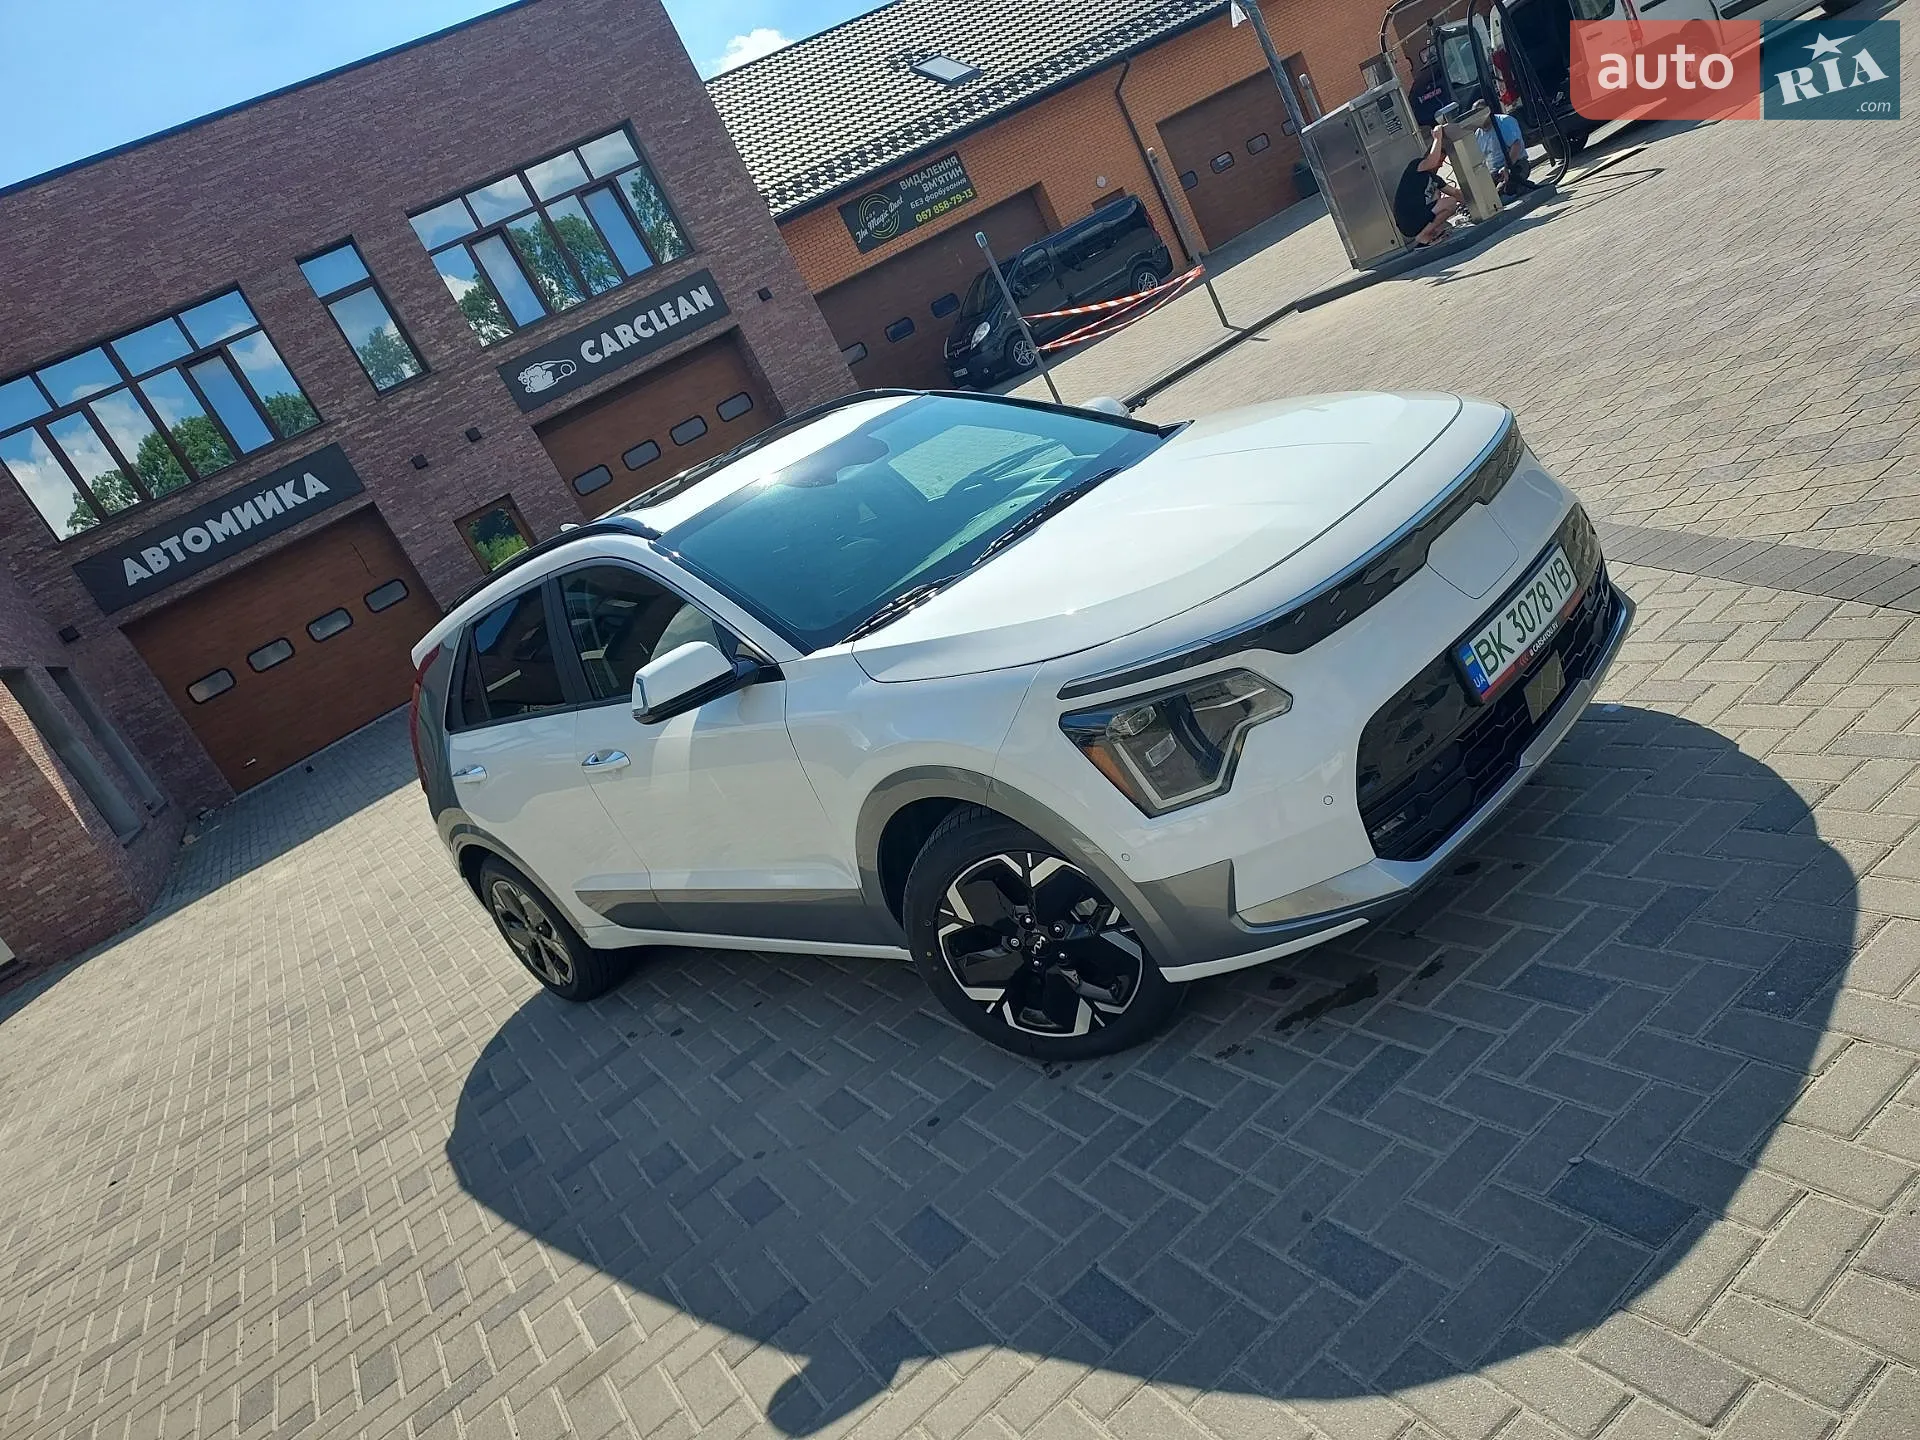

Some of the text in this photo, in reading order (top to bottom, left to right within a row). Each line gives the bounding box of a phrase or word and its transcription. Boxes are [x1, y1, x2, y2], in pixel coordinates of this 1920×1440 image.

[899, 155, 959, 191] ВИДАЛЕННЯ
[922, 166, 964, 193] ВМ'ЯТИН
[855, 227, 869, 244] The
[867, 209, 889, 231] Magic
[889, 195, 904, 213] Dent
[910, 197, 925, 209] БЕЗ
[915, 208, 933, 223] 067
[933, 188, 974, 215] 858-79-13
[580, 285, 715, 364] CARCLEAN
[122, 472, 331, 586] АВТОМИЙКА
[1474, 557, 1572, 677] BK 3078 YB
[1473, 676, 1486, 688] UA
